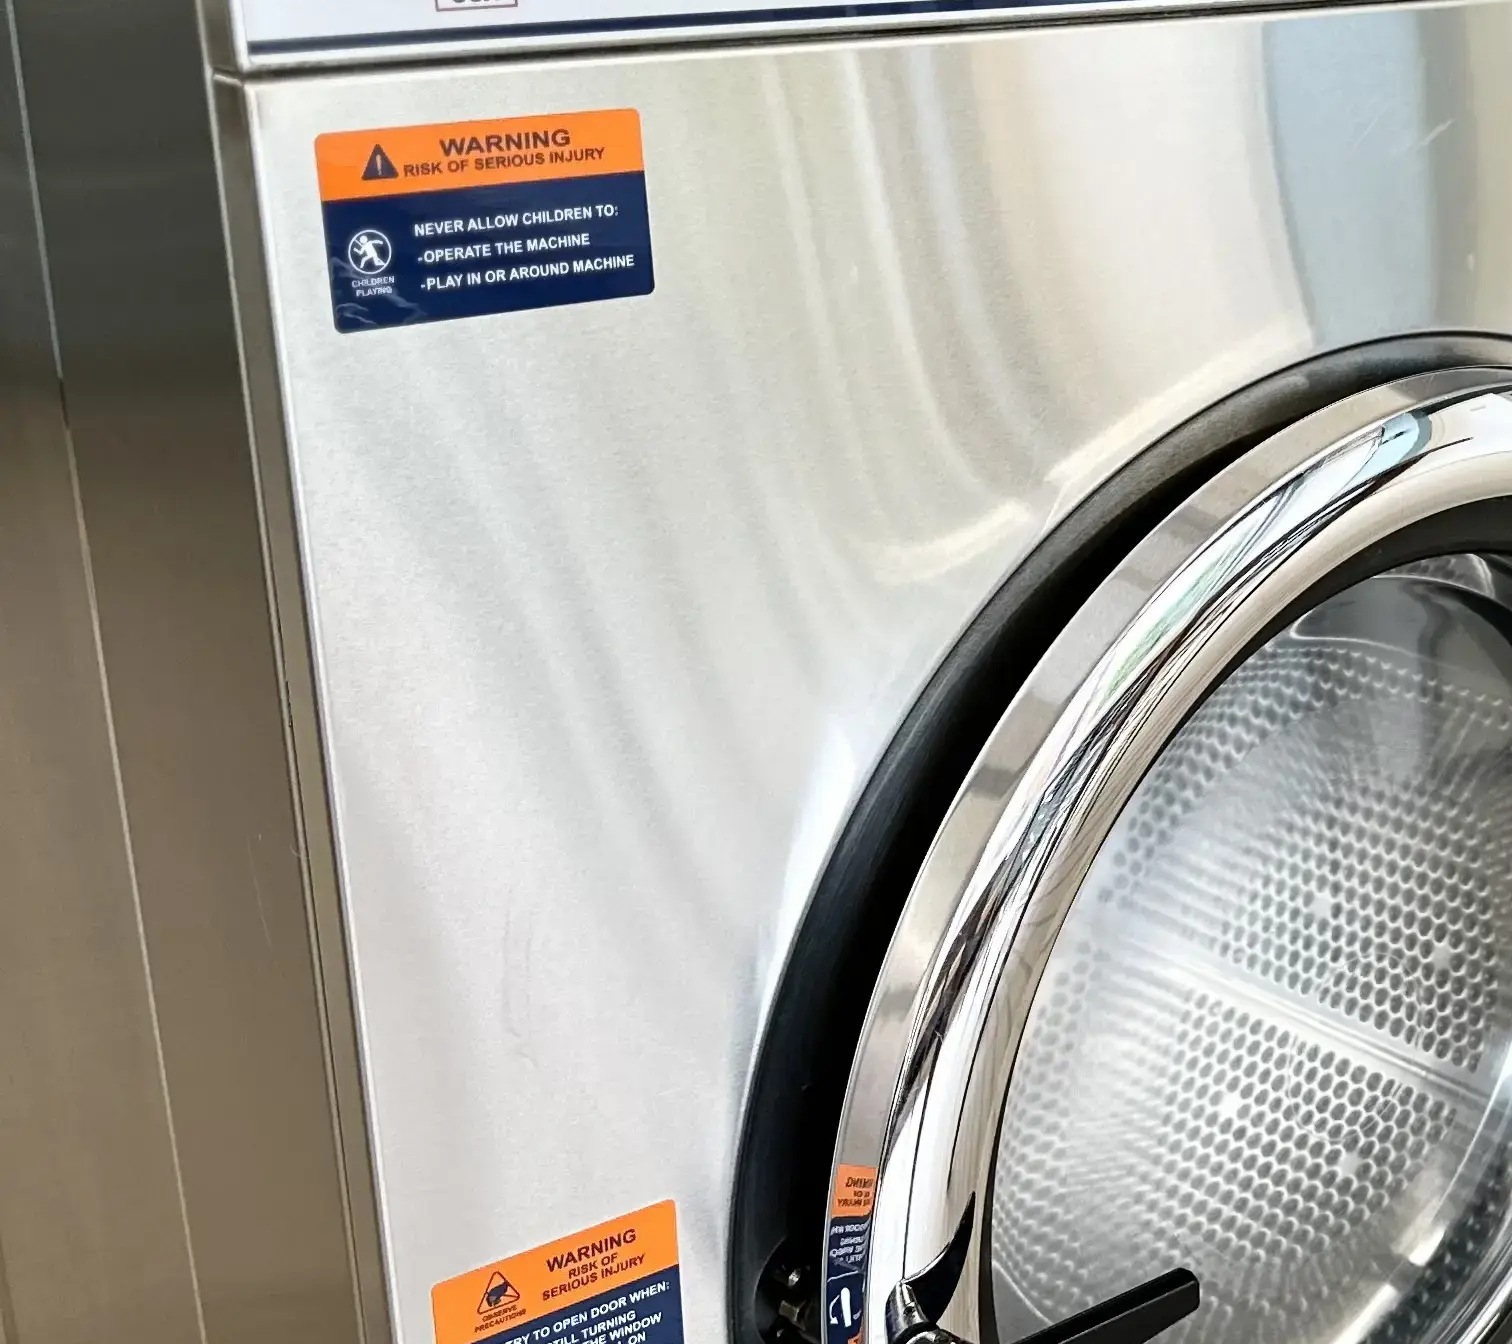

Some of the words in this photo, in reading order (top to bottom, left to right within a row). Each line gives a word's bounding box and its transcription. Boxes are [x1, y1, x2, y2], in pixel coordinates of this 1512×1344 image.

[440, 128, 570, 156] WARNING
[404, 163, 441, 177] RISK
[448, 160, 469, 173] OF
[475, 153, 543, 171] SERIOUS
[549, 147, 605, 164] INJURY
[415, 221, 464, 237] NEVER
[468, 215, 518, 231] ALLOW
[523, 206, 592, 225] CHILDREN
[596, 205, 618, 217] TO:
[418, 243, 491, 264] -OPERATE
[496, 240, 523, 255] THE
[527, 234, 590, 251] MACHINE
[421, 275, 462, 291] -PLAY
[467, 272, 481, 286] IN
[486, 269, 506, 283] OR
[510, 261, 569, 280] AROUND
[573, 255, 635, 274] MACHINE
[546, 1229, 636, 1272] WARNING
[568, 1261, 598, 1279] RISK
[601, 1253, 618, 1266] OF
[542, 1273, 597, 1301] SERIOUS
[601, 1254, 645, 1279] INJURY
[534, 1328, 550, 1343] TO
[553, 1312, 588, 1335] OPEN
[591, 1296, 626, 1318] DOOR
[629, 1281, 670, 1305] WHEN:
[581, 1310, 636, 1340] TURNING
[610, 1312, 662, 1343] WINDOW
